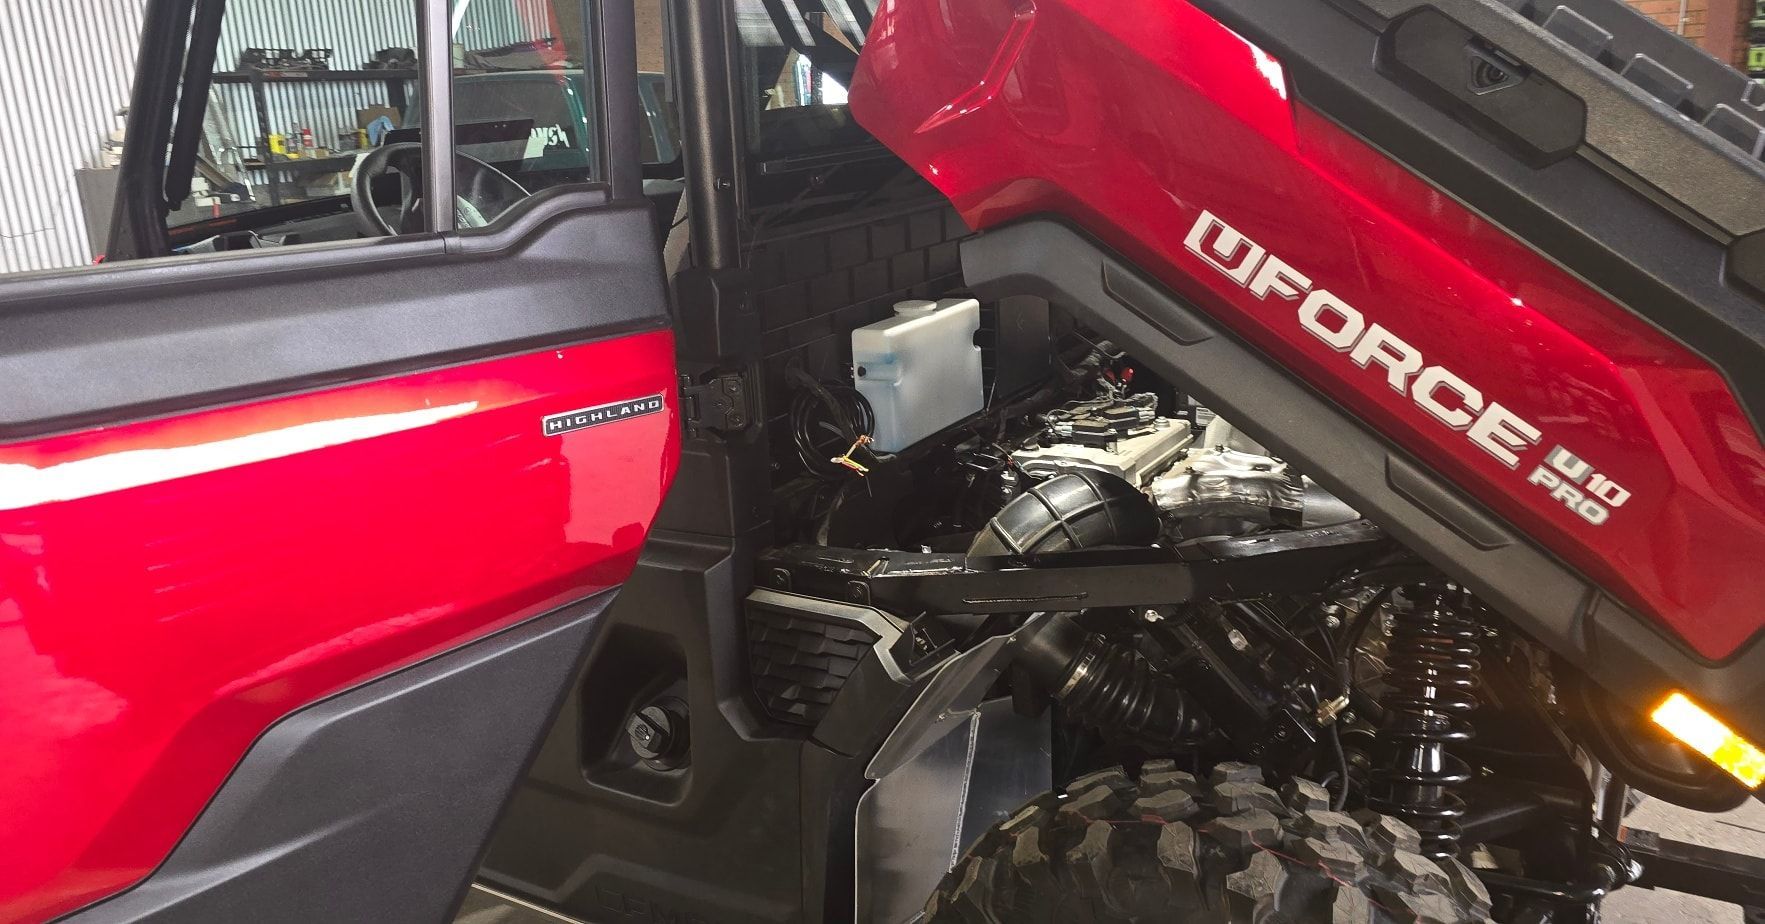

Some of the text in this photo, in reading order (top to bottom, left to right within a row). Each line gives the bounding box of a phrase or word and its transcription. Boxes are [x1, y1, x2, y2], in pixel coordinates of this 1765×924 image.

[1183, 209, 1542, 470] UFORCE
[549, 400, 660, 430] HIGHLAND
[1526, 464, 1609, 526] PRO
[1543, 444, 1632, 508] U10
